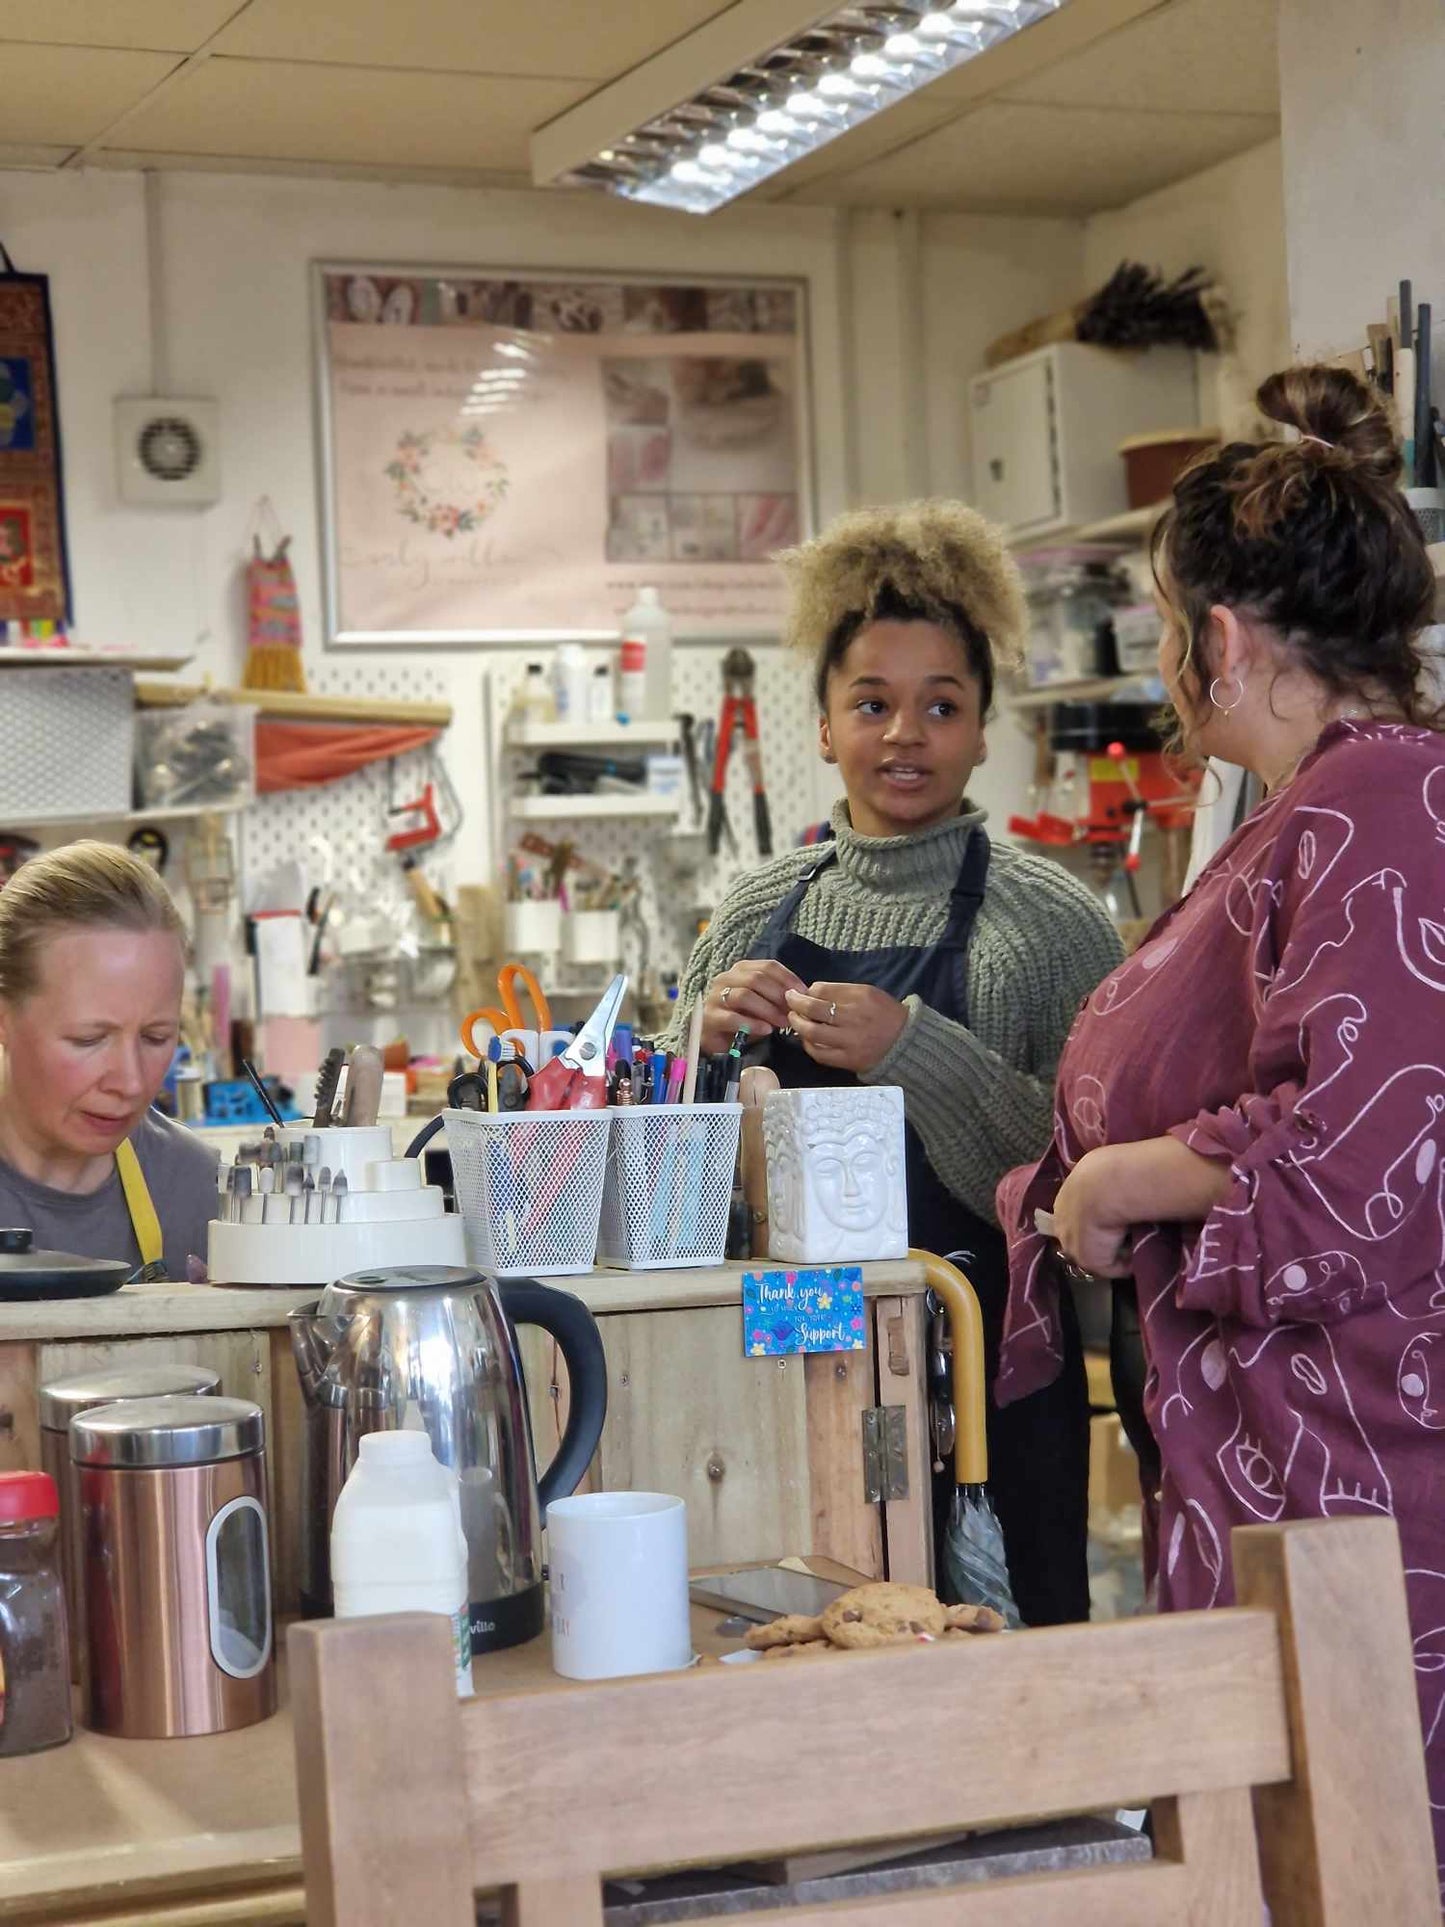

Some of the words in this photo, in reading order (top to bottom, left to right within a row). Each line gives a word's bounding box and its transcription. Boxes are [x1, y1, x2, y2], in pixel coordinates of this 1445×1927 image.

[756, 1283, 795, 1303] Thank
[798, 1285, 823, 1311] you
[795, 1322, 846, 1345] Support
[469, 1620, 496, 1635] vill
